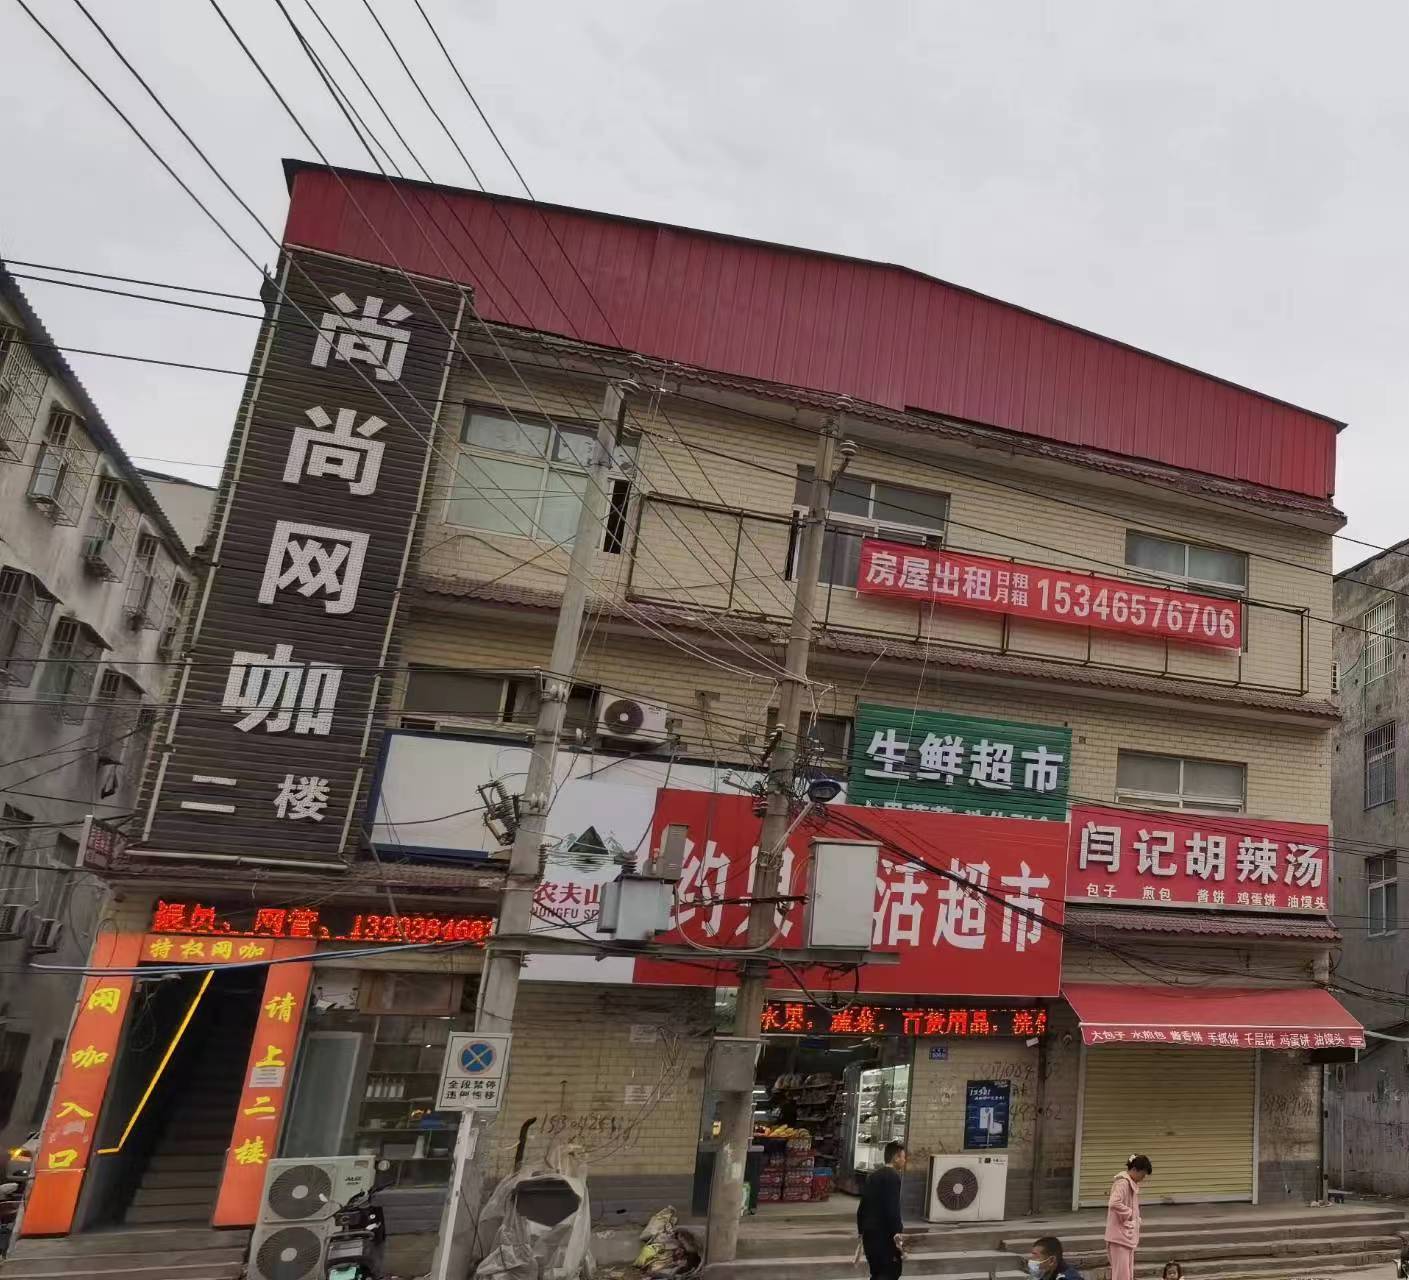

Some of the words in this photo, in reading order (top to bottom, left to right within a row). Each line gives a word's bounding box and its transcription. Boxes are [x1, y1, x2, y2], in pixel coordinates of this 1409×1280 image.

[221, 292, 414, 735] 尚尚网咖
[865, 550, 992, 601] 房屋出租
[996, 569, 1029, 591] 日租
[1036, 577, 1236, 640] 15346576706
[993, 589, 1029, 609] 月租
[865, 728, 1065, 795] 生鲜超市
[180, 774, 331, 822] 二楼
[1079, 821, 1324, 888] 闫记胡辣汤
[668, 838, 1052, 952] 约活超市
[1086, 883, 1117, 898] 包子
[1141, 885, 1172, 901] 煎包
[1197, 888, 1225, 905] 酱饼
[1237, 891, 1277, 907] 鸡蛋饼
[1287, 895, 1327, 910] 油馍头
[150, 938, 264, 960] 特权网咖
[1091, 1030, 1126, 1041] 大包子
[1131, 1030, 1167, 1041] 水煎包
[1244, 1032, 1276, 1046] 千层饼
[48, 987, 121, 1167] 网咖入口
[234, 993, 297, 1166] 请上二楼
